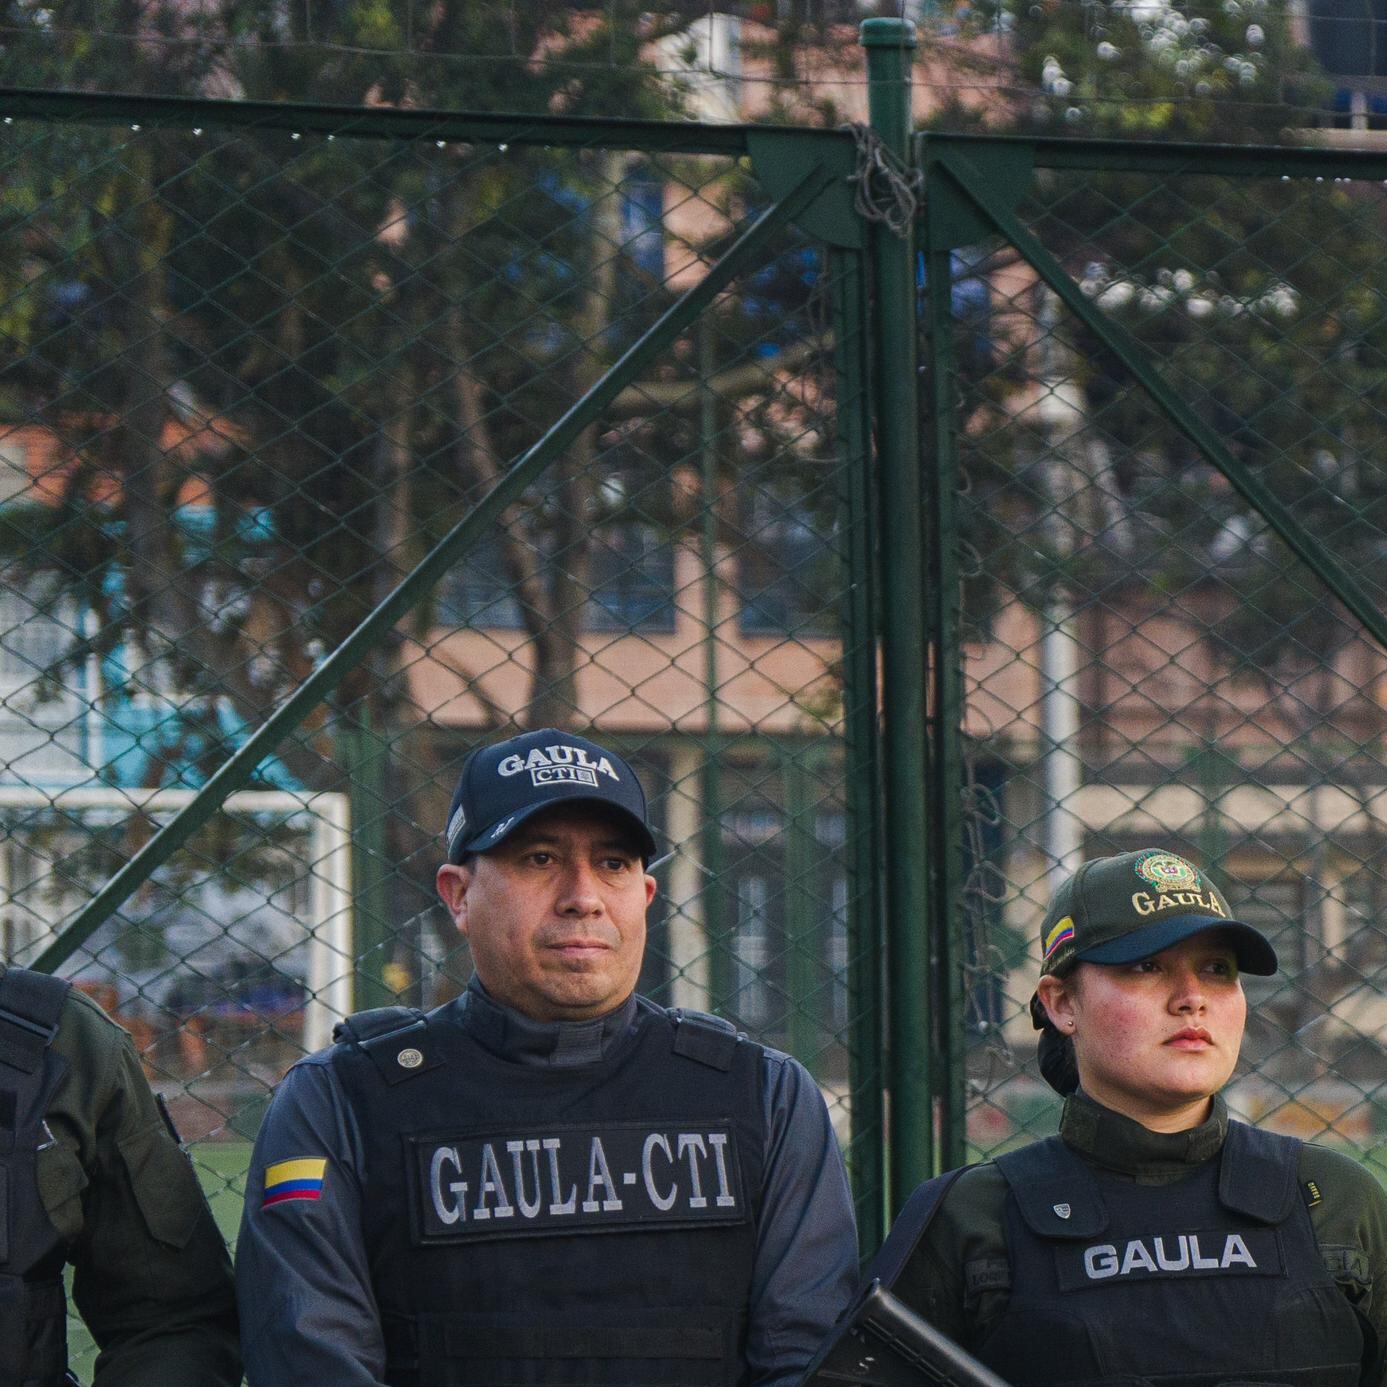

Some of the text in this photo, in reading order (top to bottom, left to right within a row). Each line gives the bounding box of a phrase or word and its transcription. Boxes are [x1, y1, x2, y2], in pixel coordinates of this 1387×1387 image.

[497, 745, 620, 782] GAULA
[536, 767, 577, 781] CTI
[1131, 891, 1226, 918] GAULA
[430, 1132, 736, 1225] GAULA-CTI
[1084, 1234, 1257, 1279] GAULA
